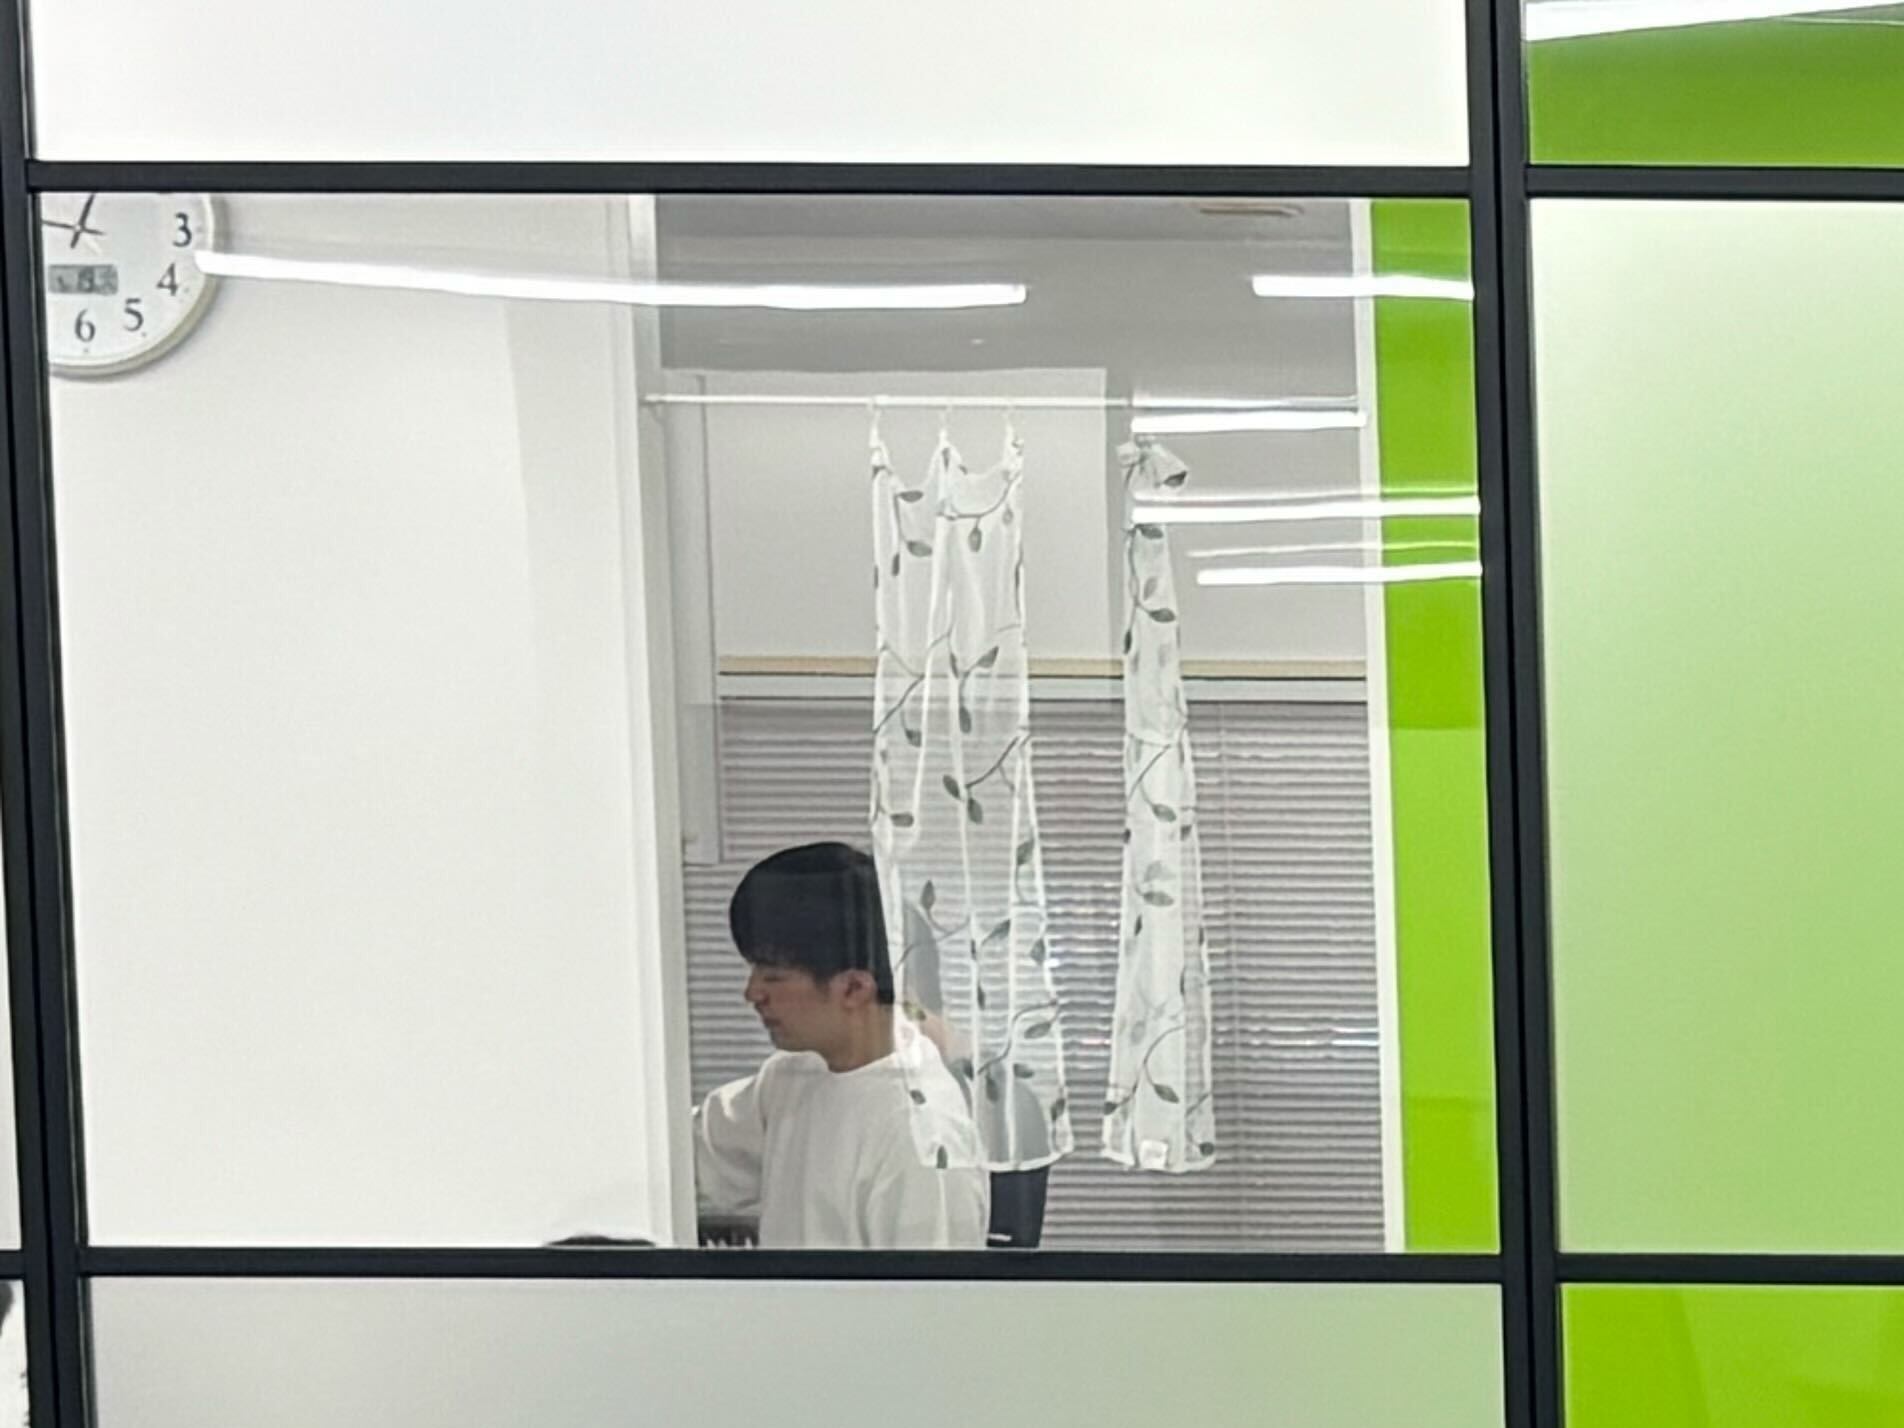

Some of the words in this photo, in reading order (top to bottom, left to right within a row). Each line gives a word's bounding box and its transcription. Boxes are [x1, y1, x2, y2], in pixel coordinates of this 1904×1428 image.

[173, 212, 192, 247] 3
[156, 263, 178, 296] 4
[75, 310, 96, 342] 6
[123, 298, 144, 331] 5
